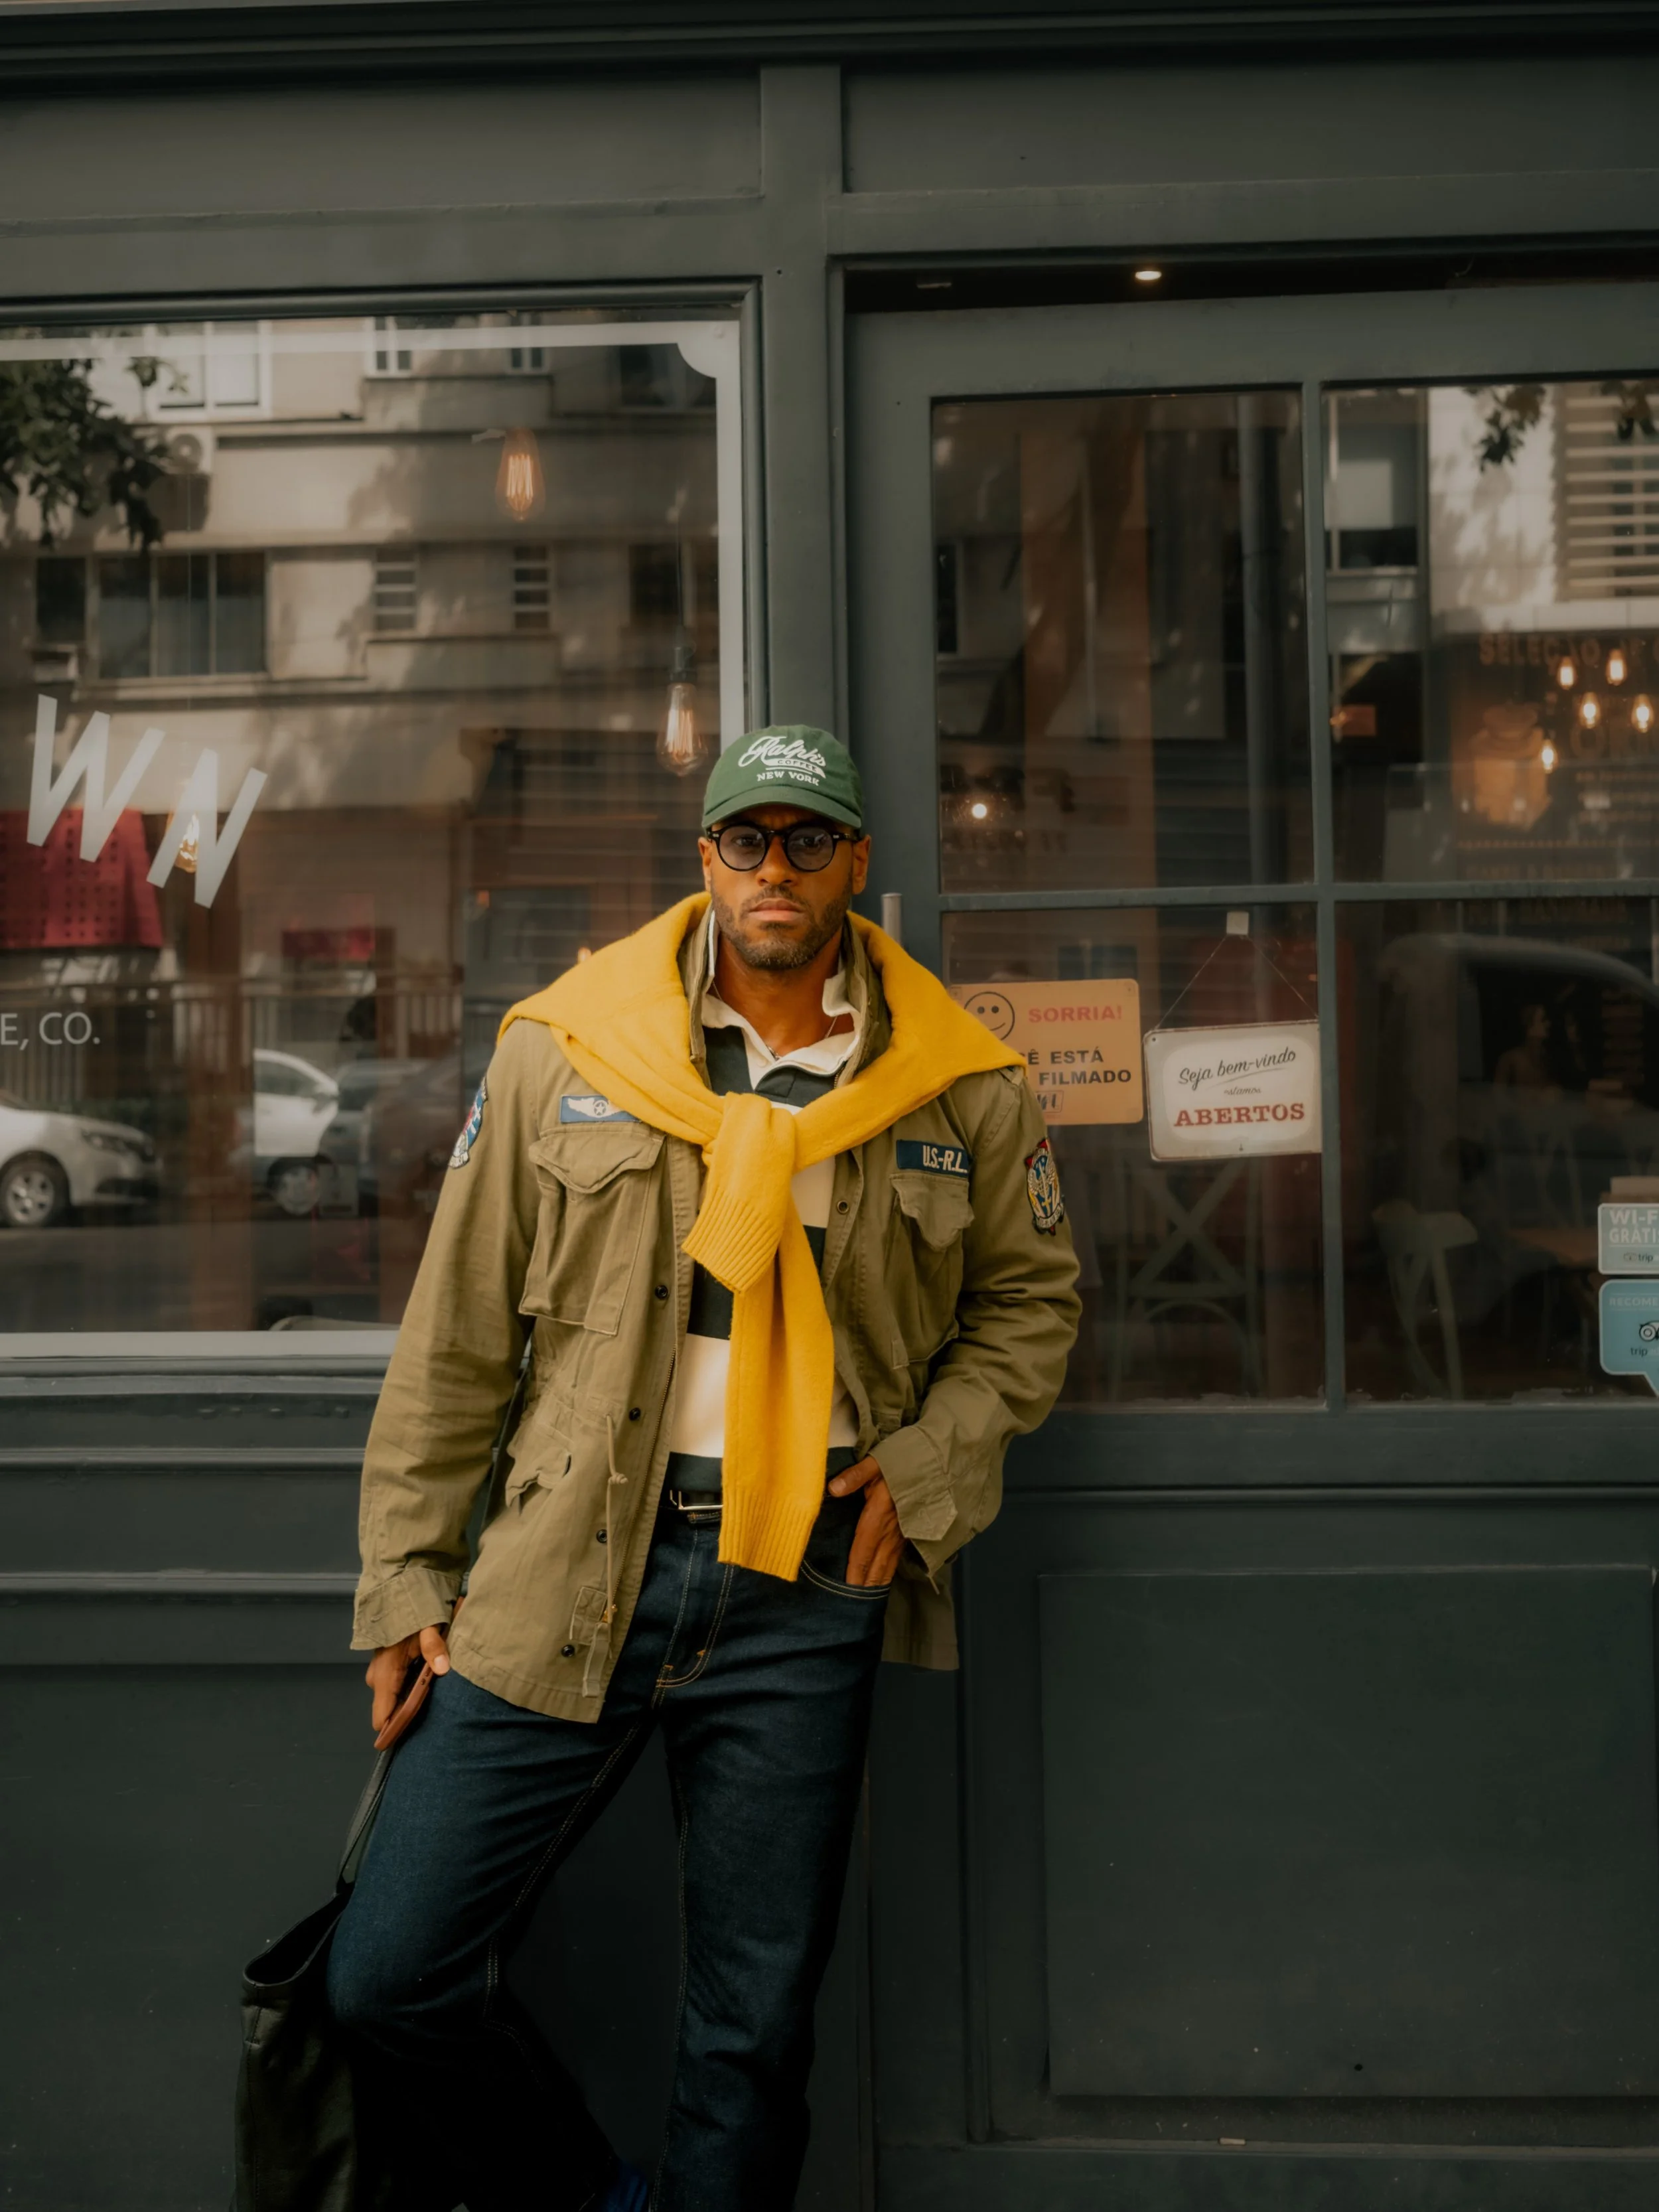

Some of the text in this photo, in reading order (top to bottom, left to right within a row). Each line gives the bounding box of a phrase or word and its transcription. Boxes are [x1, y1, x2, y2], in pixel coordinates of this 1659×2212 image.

[738, 735, 826, 767] Ralph's
[777, 759, 818, 772] COFFEE
[757, 771, 820, 786] NEW YORK
[1028, 1005, 1123, 1023] SORRIA!
[38, 1011, 101, 1045] CO.
[1050, 1046, 1104, 1065] ESTÁ
[1039, 1069, 1132, 1086] FILMADO
[1178, 1046, 1297, 1091] Seja bem-vindo
[1173, 1102, 1305, 1127] ABERTOS
[1609, 1222, 1659, 1244] GRÁTI
[1638, 1252, 1659, 1263] trip
[1630, 1347, 1659, 1357] trip
